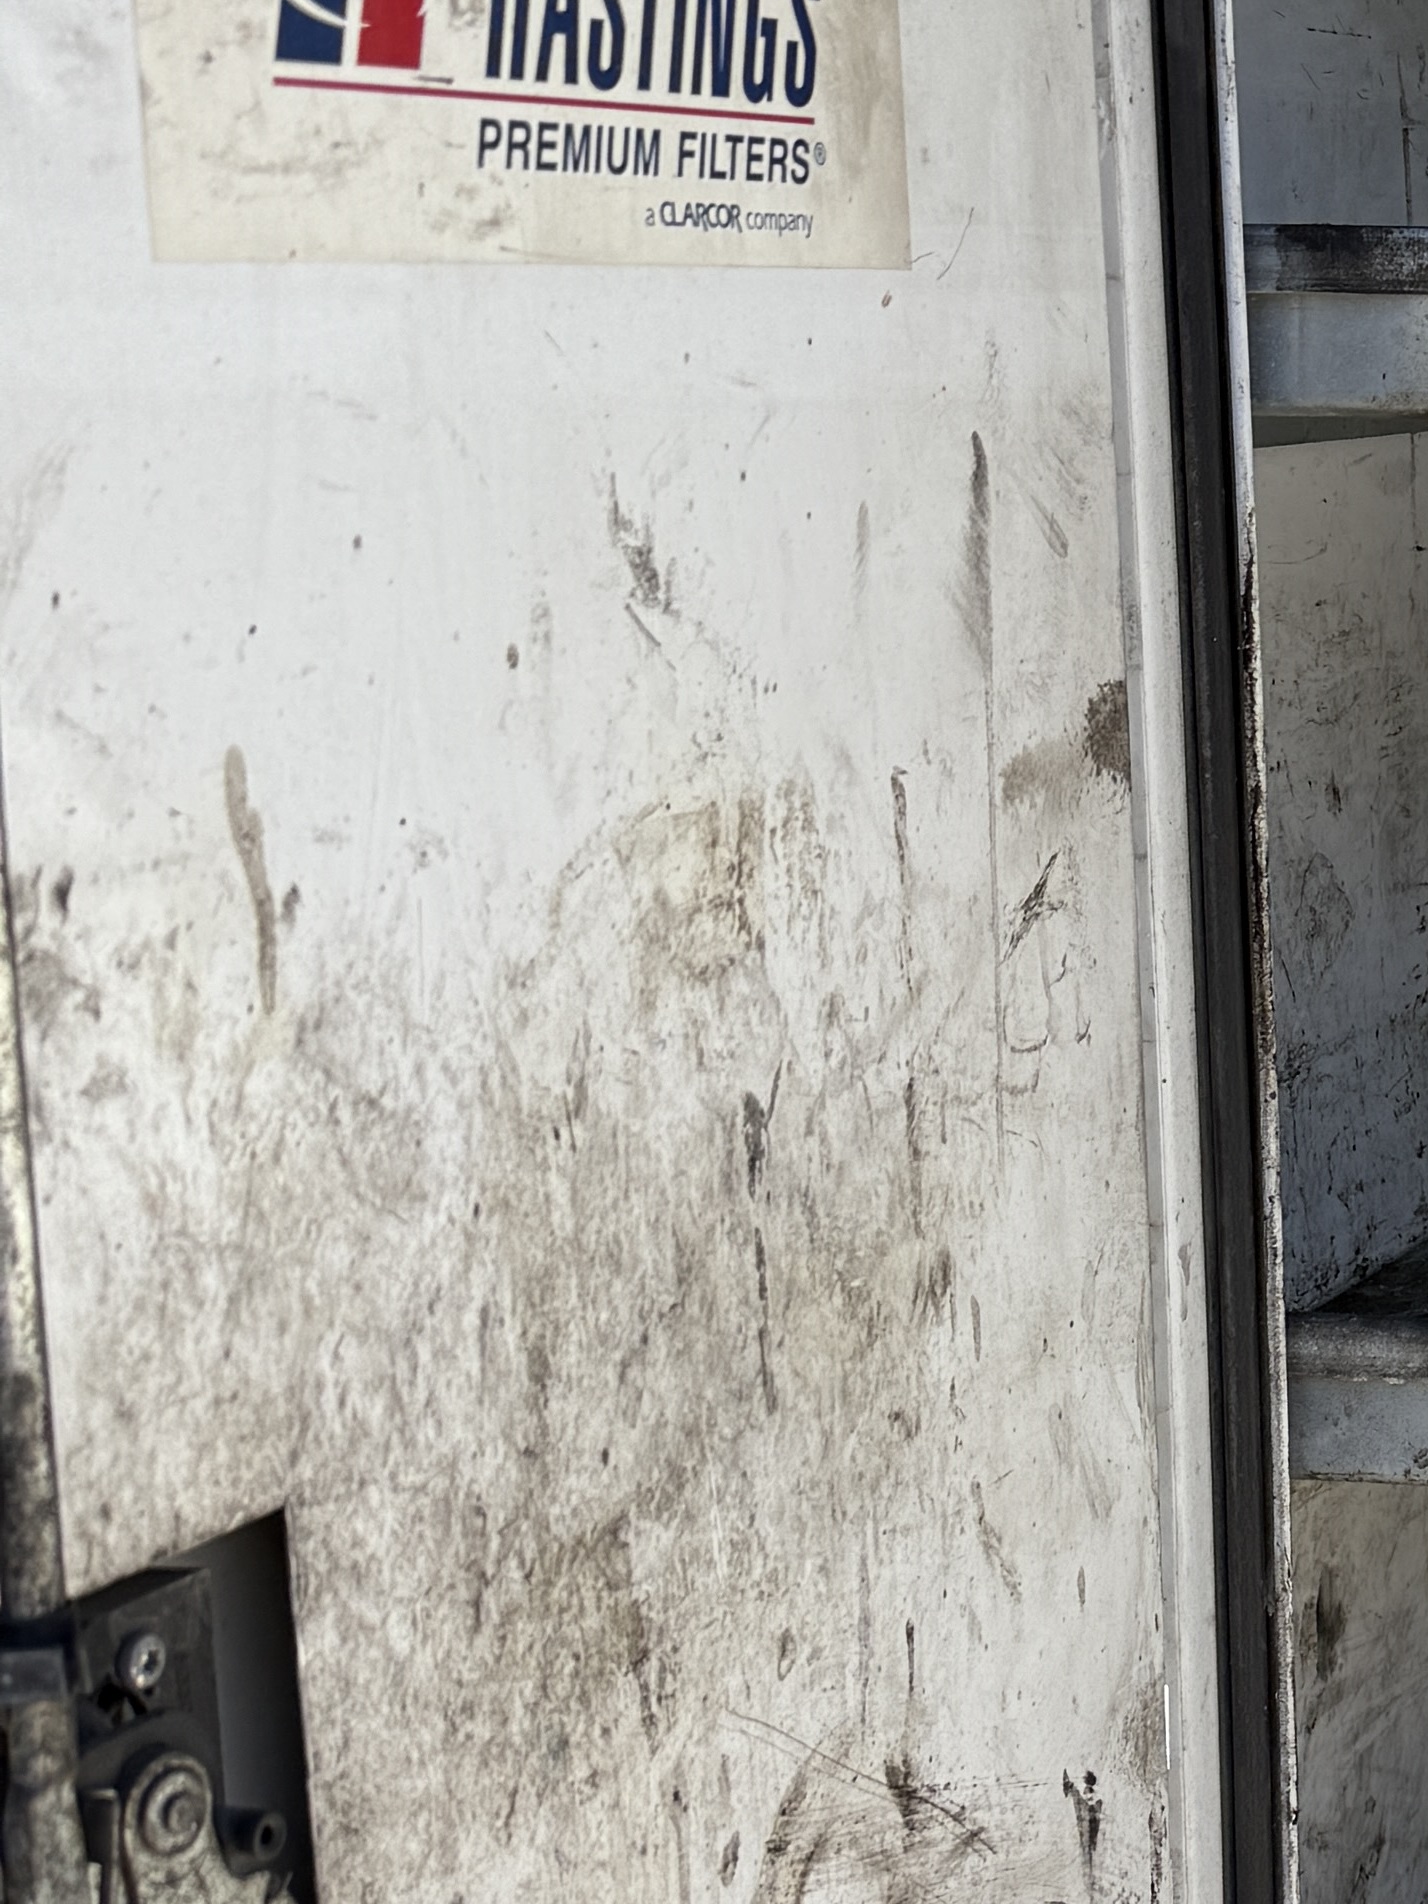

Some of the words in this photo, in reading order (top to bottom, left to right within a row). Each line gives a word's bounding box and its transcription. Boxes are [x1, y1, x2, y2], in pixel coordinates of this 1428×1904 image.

[477, 118, 661, 176] PREMIUM
[644, 208, 655, 227] a
[660, 201, 742, 233] CLARCOR
[745, 210, 814, 237] company
